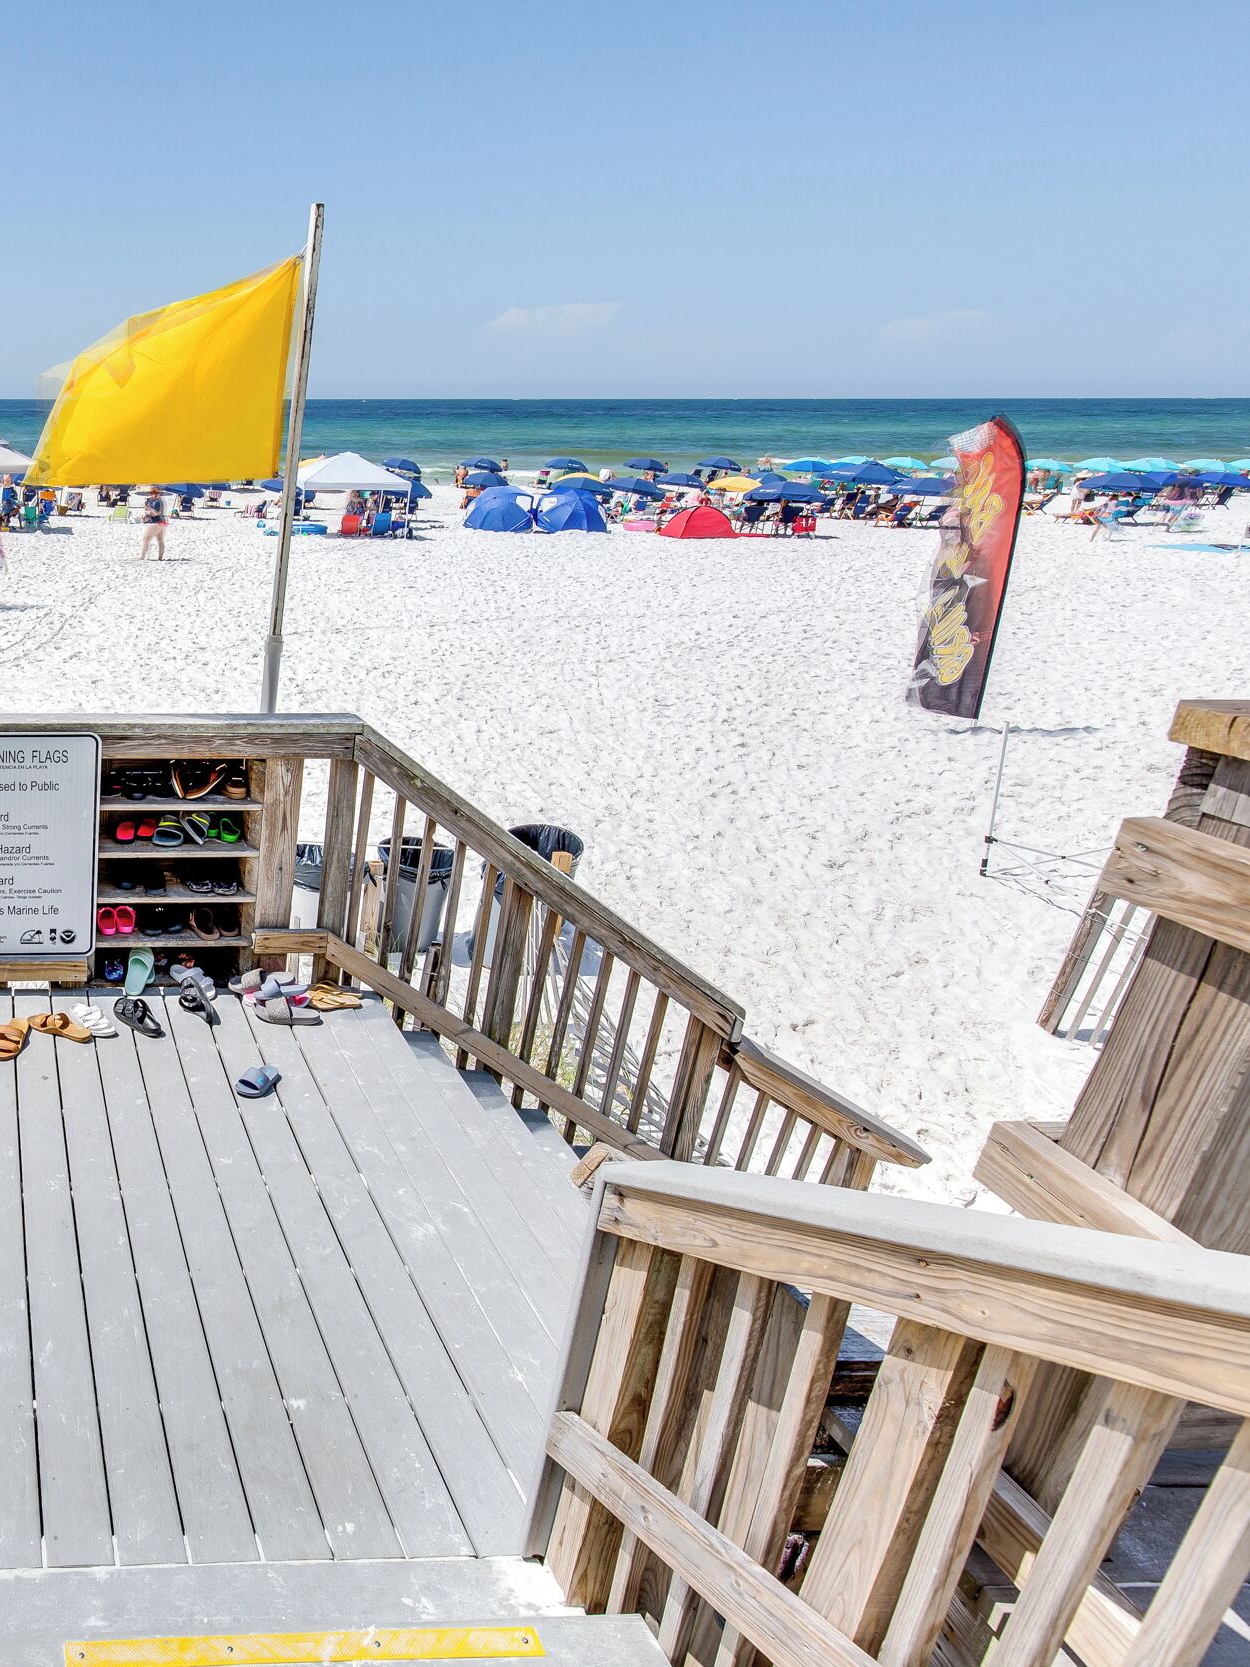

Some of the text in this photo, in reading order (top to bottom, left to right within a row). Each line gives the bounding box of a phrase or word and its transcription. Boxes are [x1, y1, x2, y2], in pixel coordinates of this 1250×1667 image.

[31, 750, 69, 764] FLAGS
[18, 781, 28, 791] to
[30, 781, 60, 791] Public
[7, 906, 39, 916] Marine
[42, 905, 59, 915] Life
